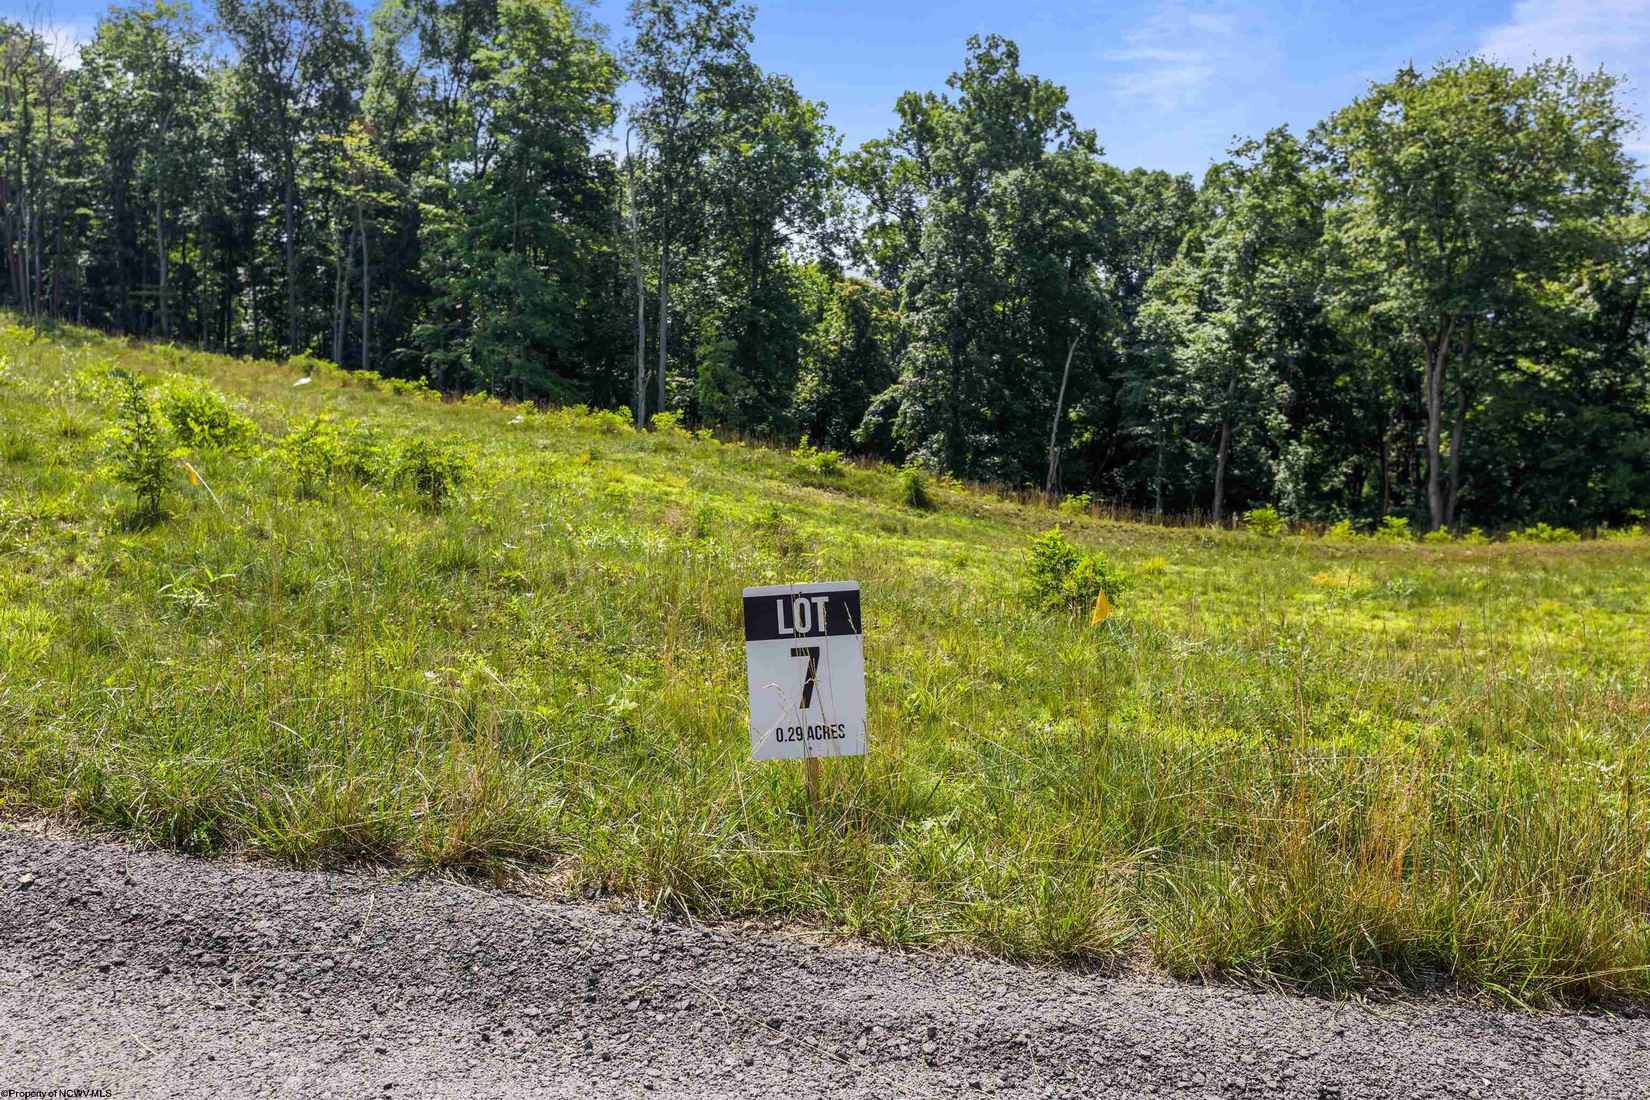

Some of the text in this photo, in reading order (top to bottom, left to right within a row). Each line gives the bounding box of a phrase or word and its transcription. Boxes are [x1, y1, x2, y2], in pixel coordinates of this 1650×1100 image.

[776, 596, 829, 635] LOT
[790, 646, 820, 709] 7
[776, 723, 846, 742] 0.29 ACRES
